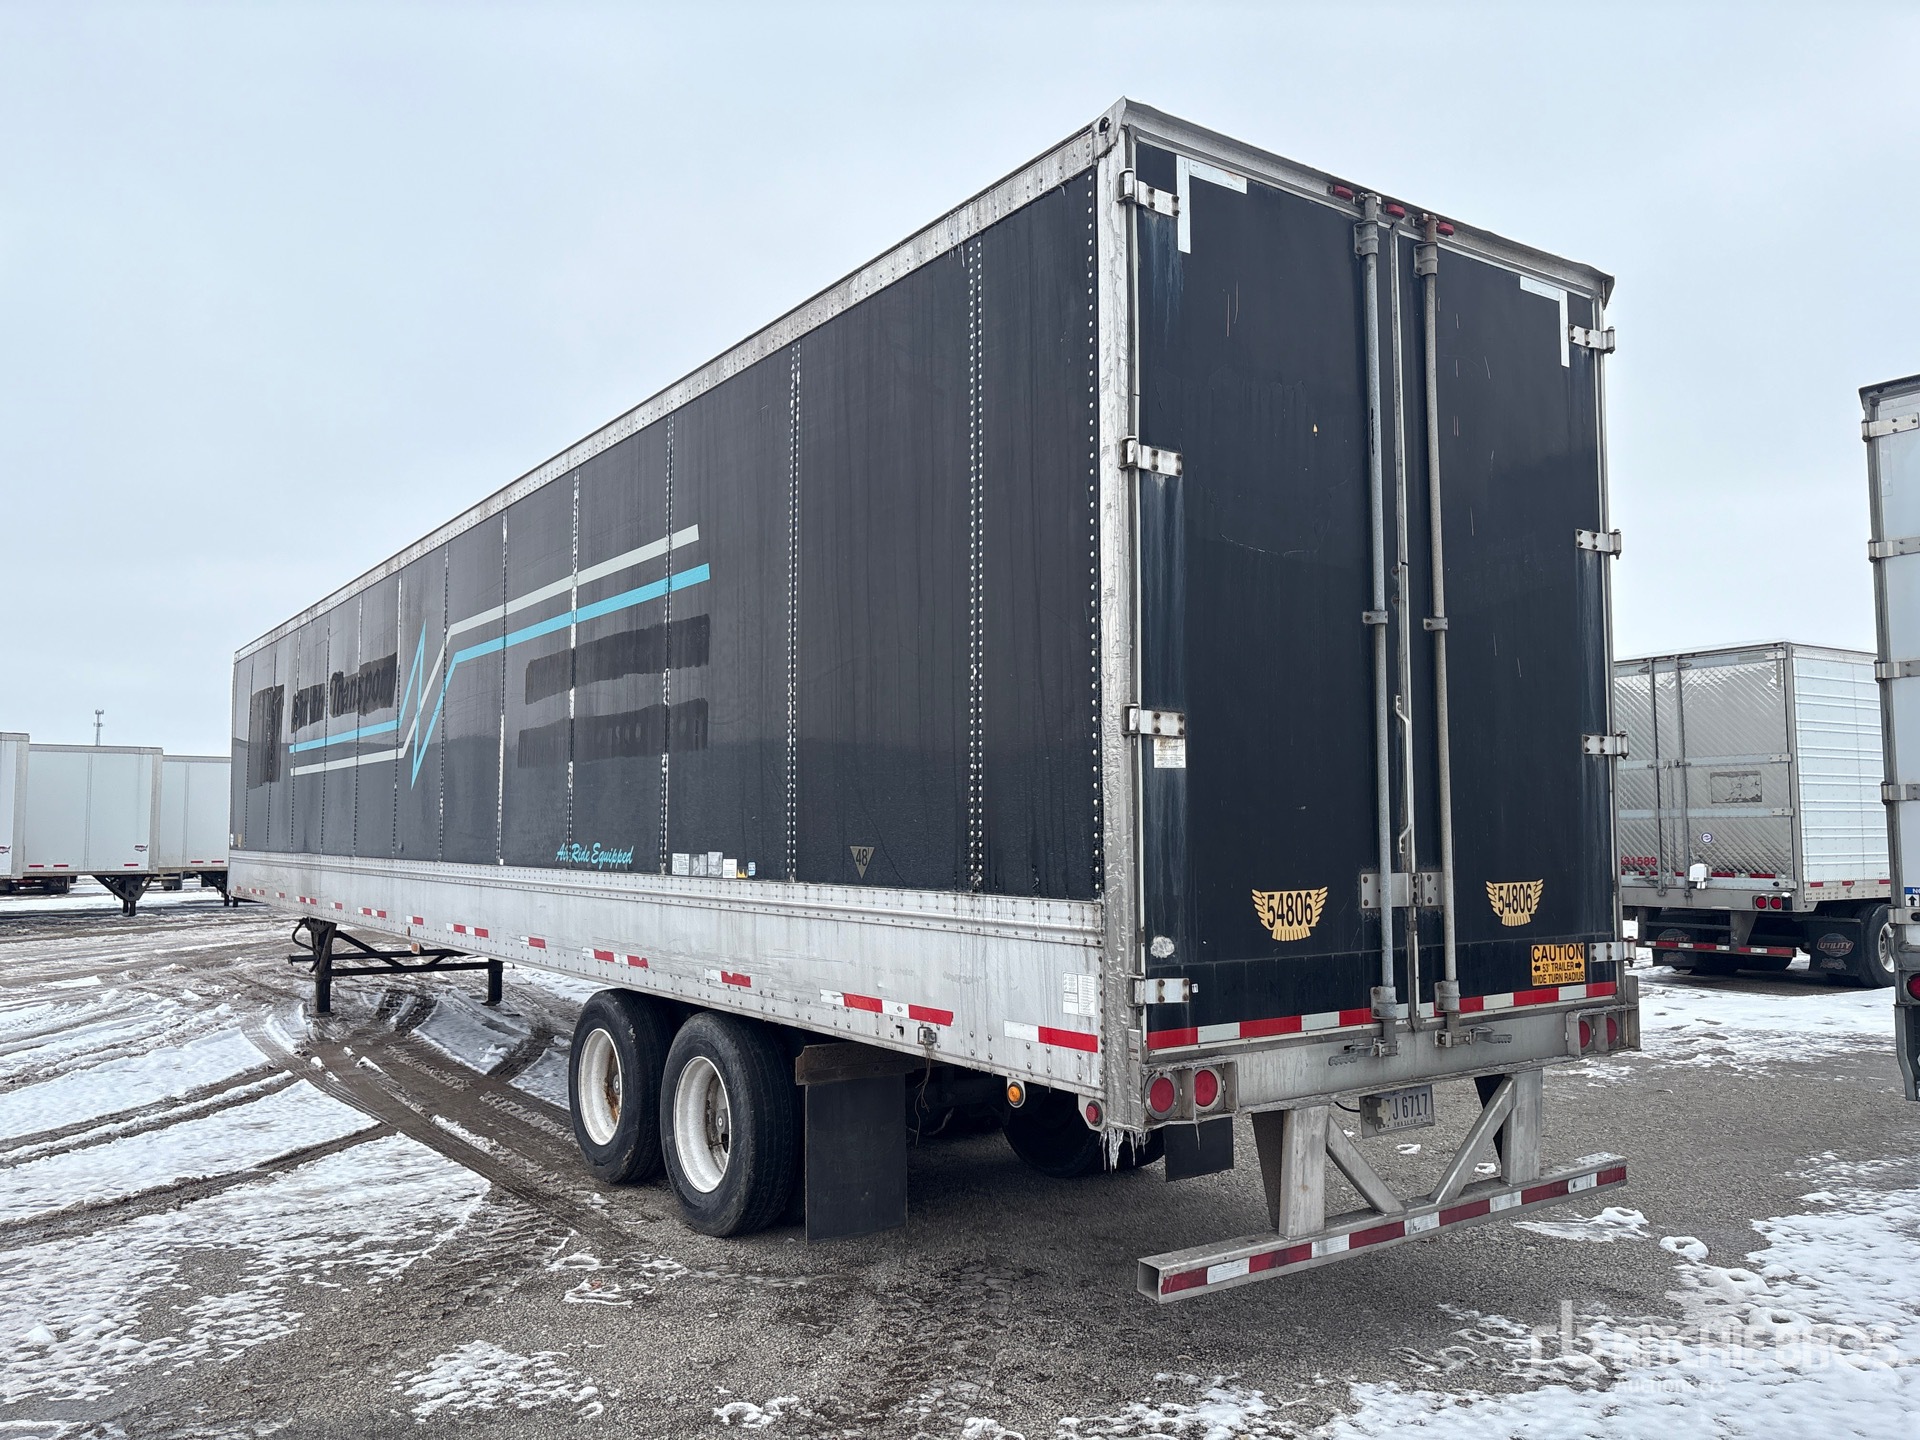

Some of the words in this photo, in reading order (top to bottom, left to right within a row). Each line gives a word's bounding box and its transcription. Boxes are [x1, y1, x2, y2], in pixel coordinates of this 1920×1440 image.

[571, 843, 590, 863] Ride
[591, 842, 634, 870] Equipped
[1267, 891, 1313, 928] 54806
[1498, 883, 1533, 915] 54806
[1532, 944, 1584, 962] CAUTION
[1532, 974, 1547, 985] WIDE
[1548, 972, 1564, 983] TURN
[1564, 971, 1585, 982] RADIUS
[1551, 961, 1575, 972] TRAILER
